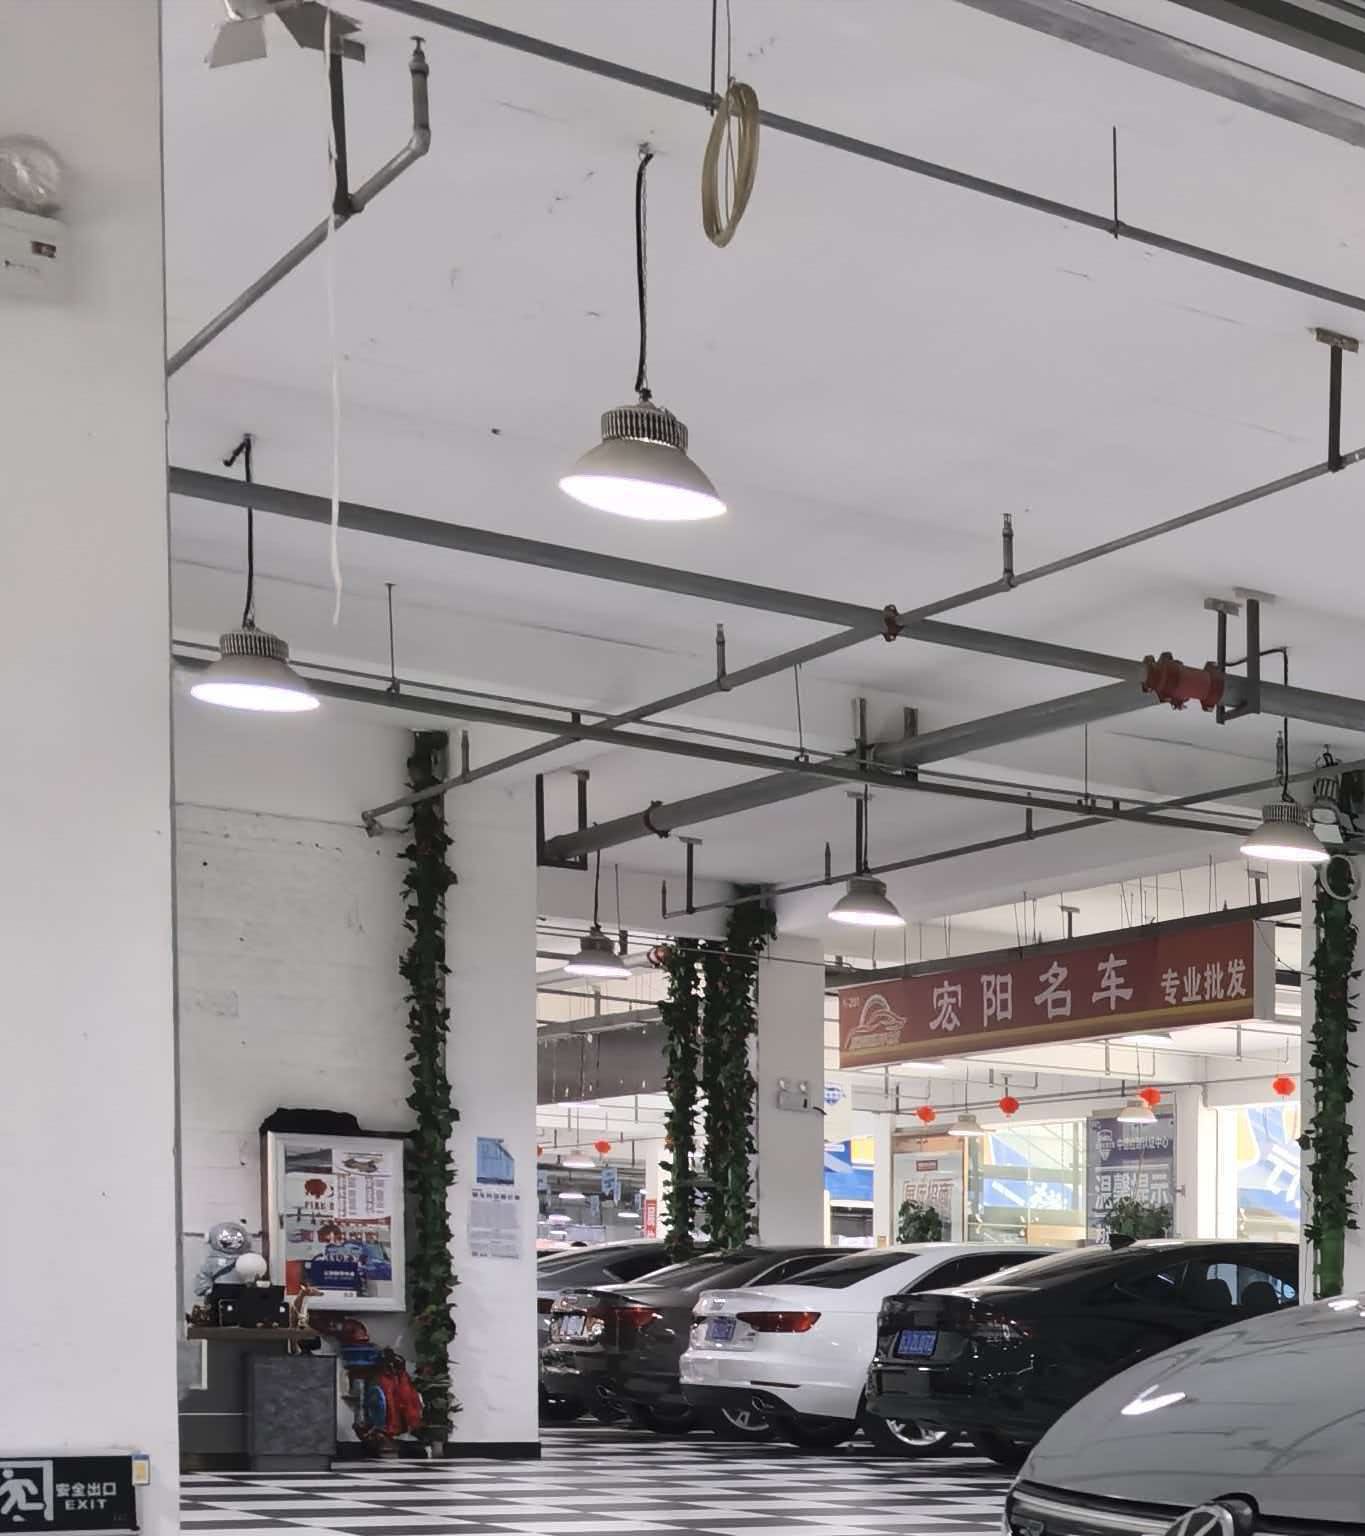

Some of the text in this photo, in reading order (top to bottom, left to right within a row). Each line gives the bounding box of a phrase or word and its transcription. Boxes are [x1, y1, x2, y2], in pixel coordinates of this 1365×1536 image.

[928, 953, 1247, 1031] 宏阳名车 专业批发
[55, 1482, 117, 1498] 安全出口
[65, 1499, 107, 1511] EXIT
